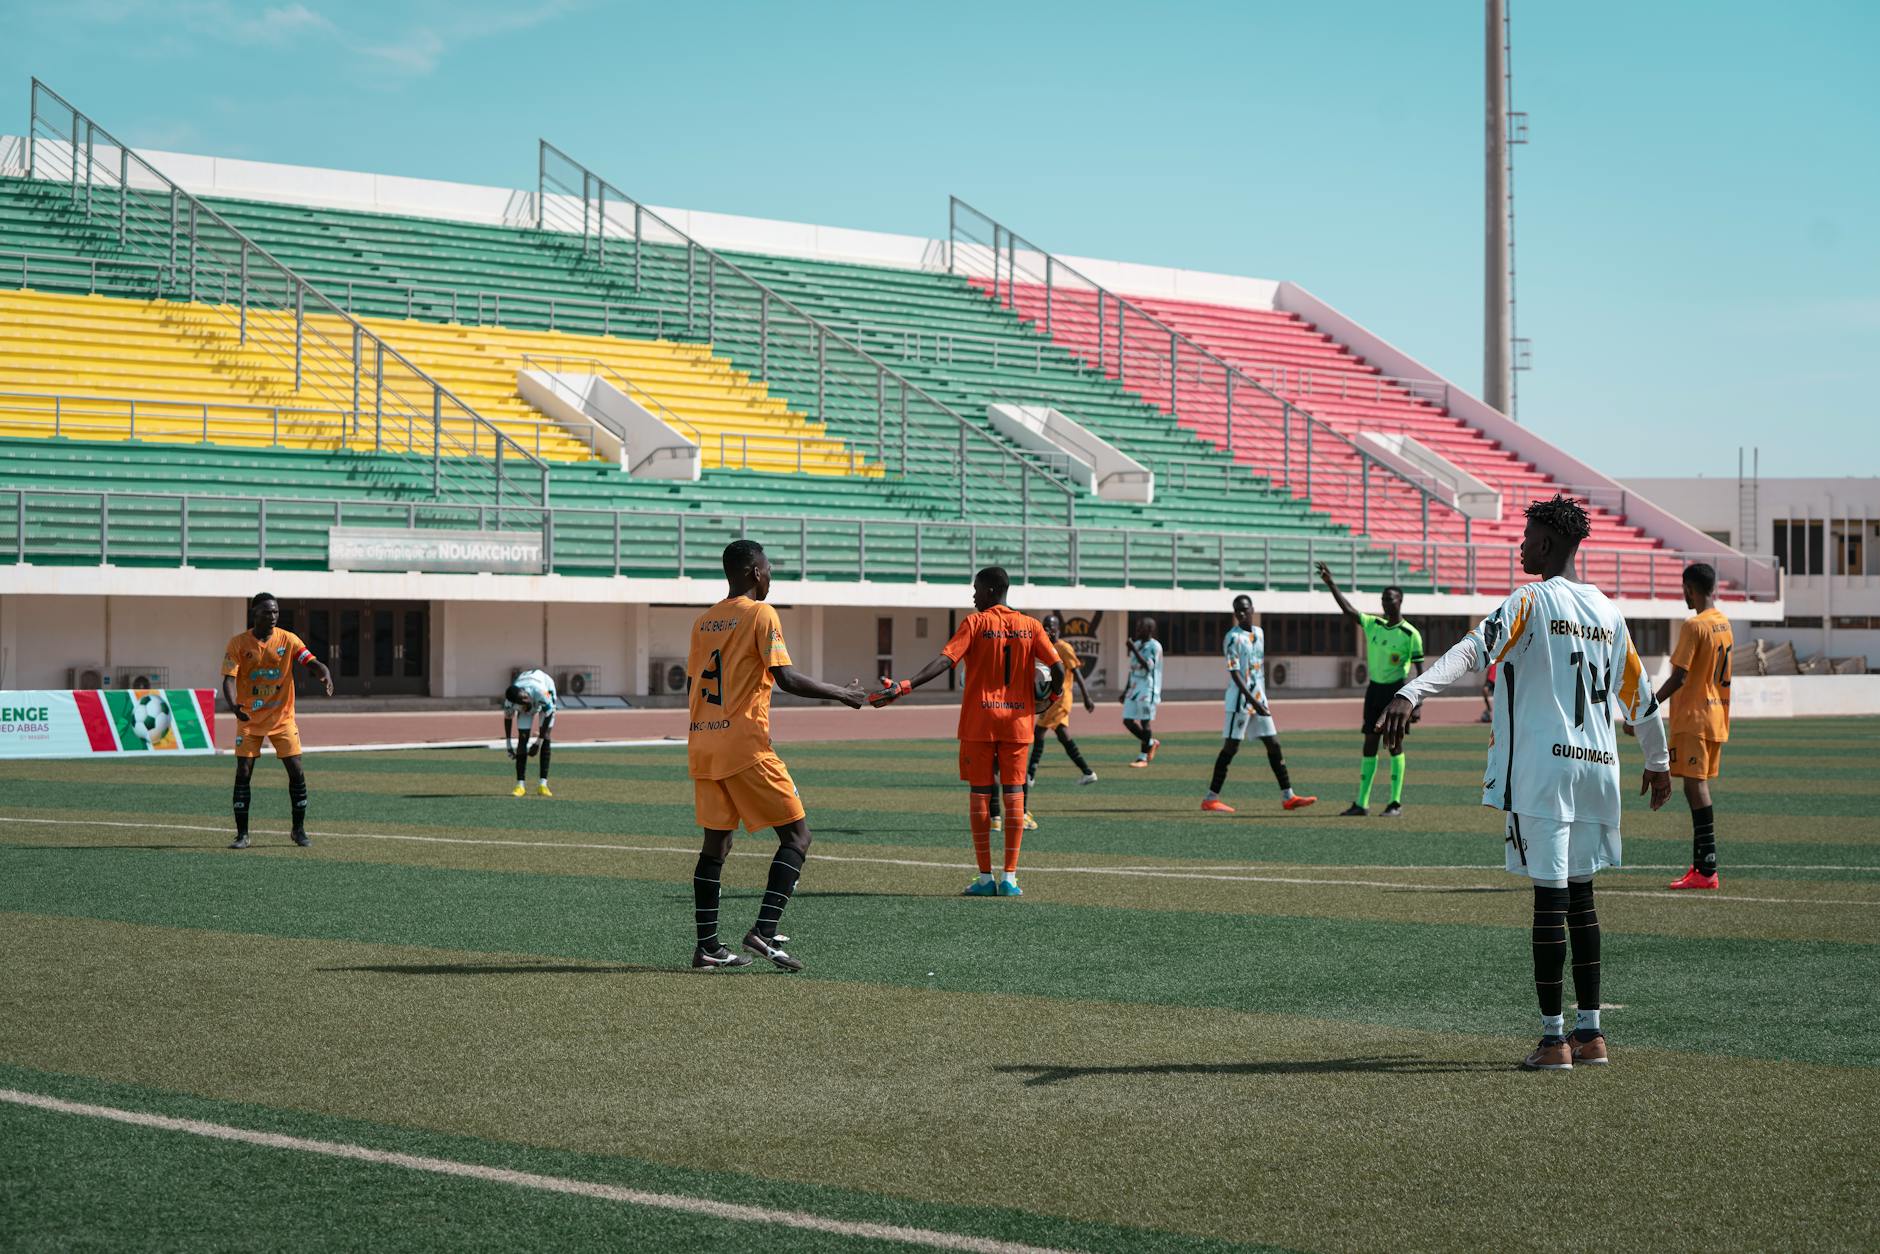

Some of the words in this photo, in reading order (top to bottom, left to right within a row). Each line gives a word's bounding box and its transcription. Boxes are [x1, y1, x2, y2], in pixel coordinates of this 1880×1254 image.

[438, 542, 539, 562] NOUAKCHOTT
[1072, 640, 1101, 655] SSFIT
[1004, 645, 1012, 687] 1
[1570, 651, 1611, 732] 14
[0, 707, 48, 722] ENGE
[0, 724, 14, 733] ED
[17, 723, 49, 732] ABBAS
[1552, 743, 1616, 765] GUIDIMAGH
